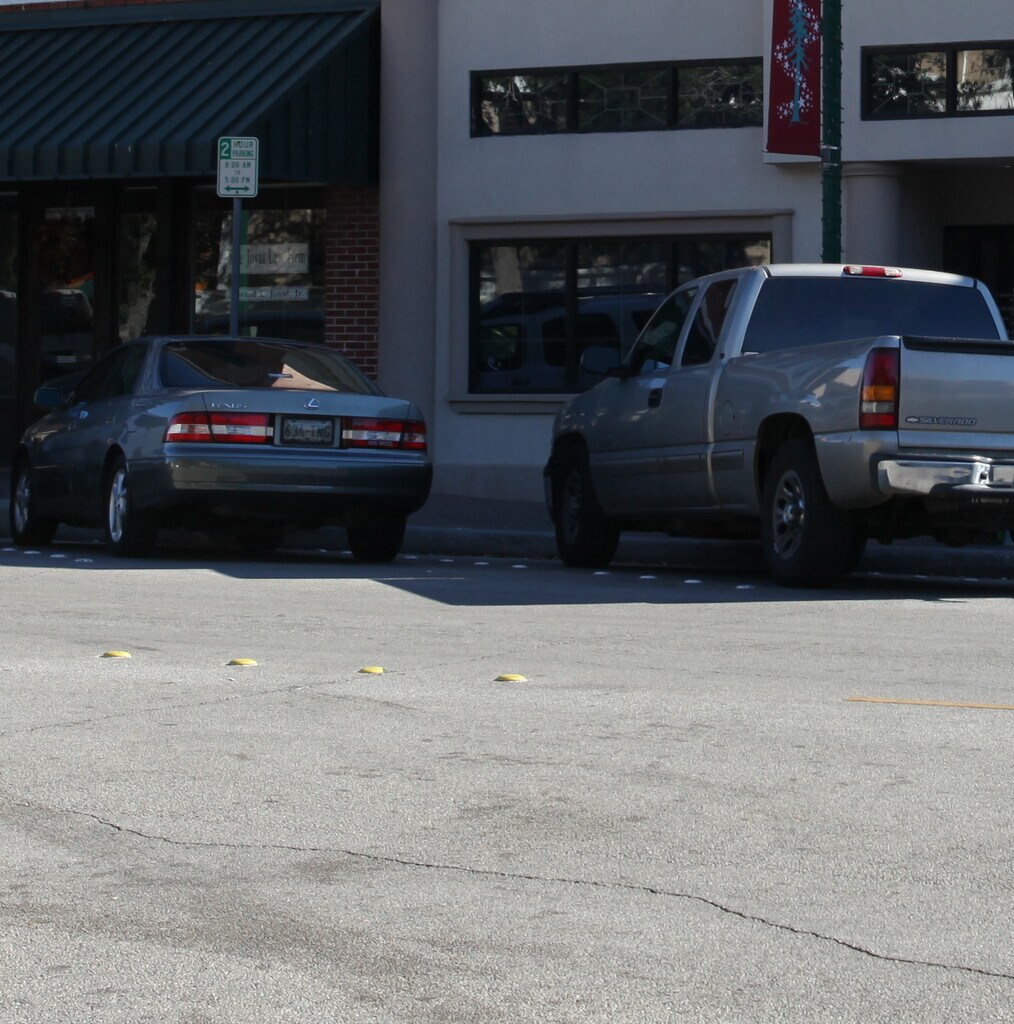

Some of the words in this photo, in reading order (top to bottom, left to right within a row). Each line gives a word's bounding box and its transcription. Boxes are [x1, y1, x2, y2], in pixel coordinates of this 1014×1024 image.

[221, 141, 230, 157] 2
[233, 140, 254, 149] HOUR
[232, 149, 254, 157] PARKING
[225, 161, 240, 169] 8:00
[242, 161, 251, 169] AM
[919, 416, 977, 425] SILVERADO
